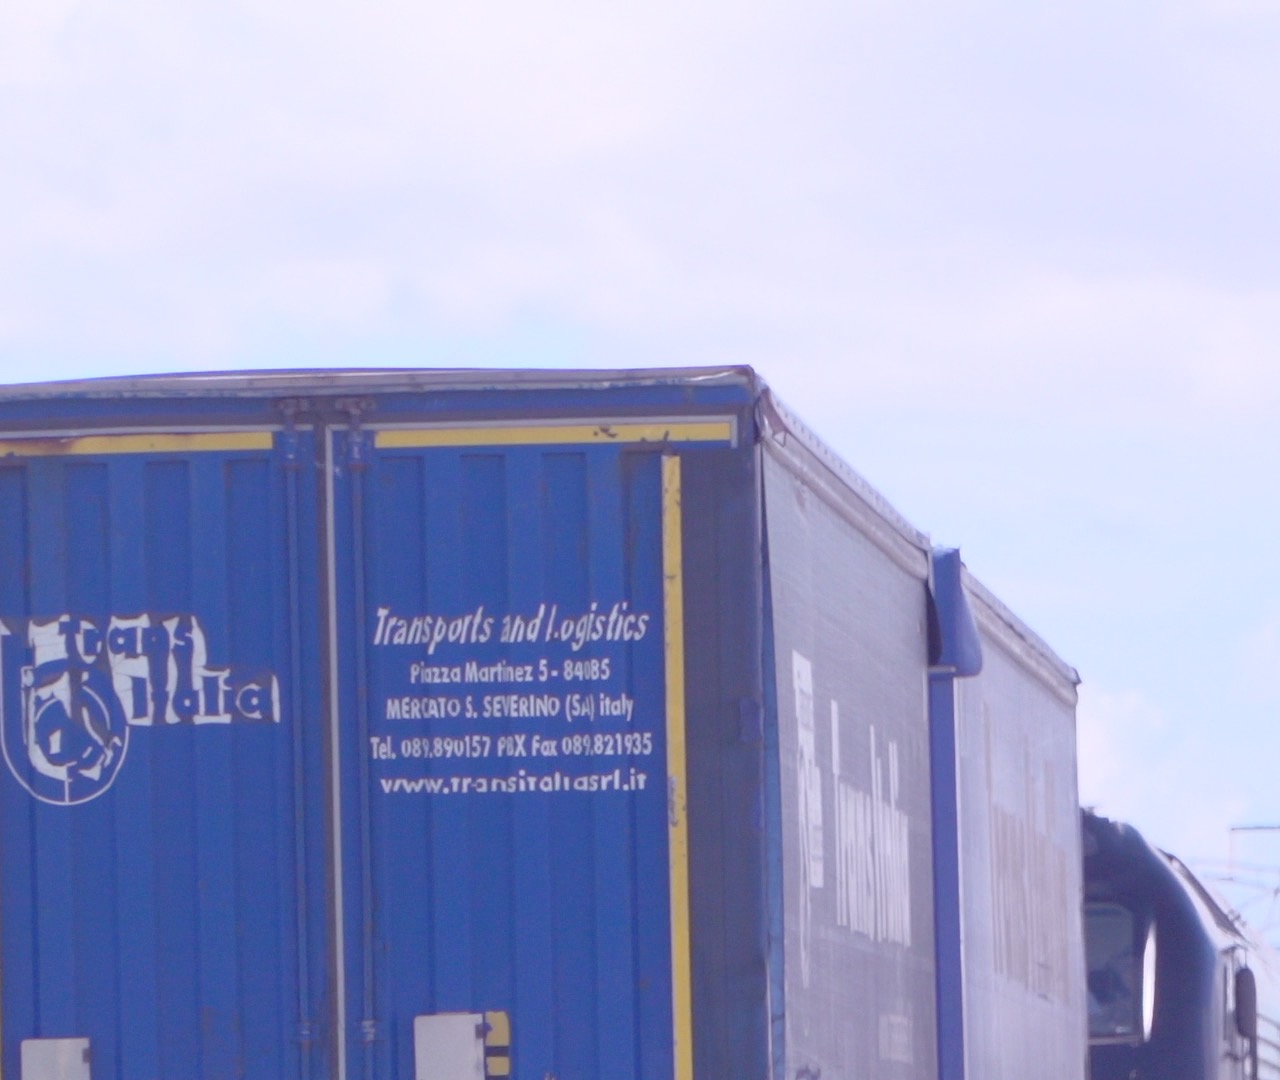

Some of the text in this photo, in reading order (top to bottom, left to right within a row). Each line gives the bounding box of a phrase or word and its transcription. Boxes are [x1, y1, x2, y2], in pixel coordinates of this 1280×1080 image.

[373, 602, 650, 655] Transports and Logistics
[410, 661, 461, 684] Piazza
[465, 659, 533, 684] Martinez
[538, 661, 548, 682] 5
[563, 658, 611, 681] 84085
[386, 697, 461, 720] MERCATO
[465, 696, 478, 719] S.
[483, 694, 560, 719] SEVERINO
[565, 693, 595, 722] (SA)
[370, 736, 397, 760] Tel.
[532, 735, 558, 757] Fax
